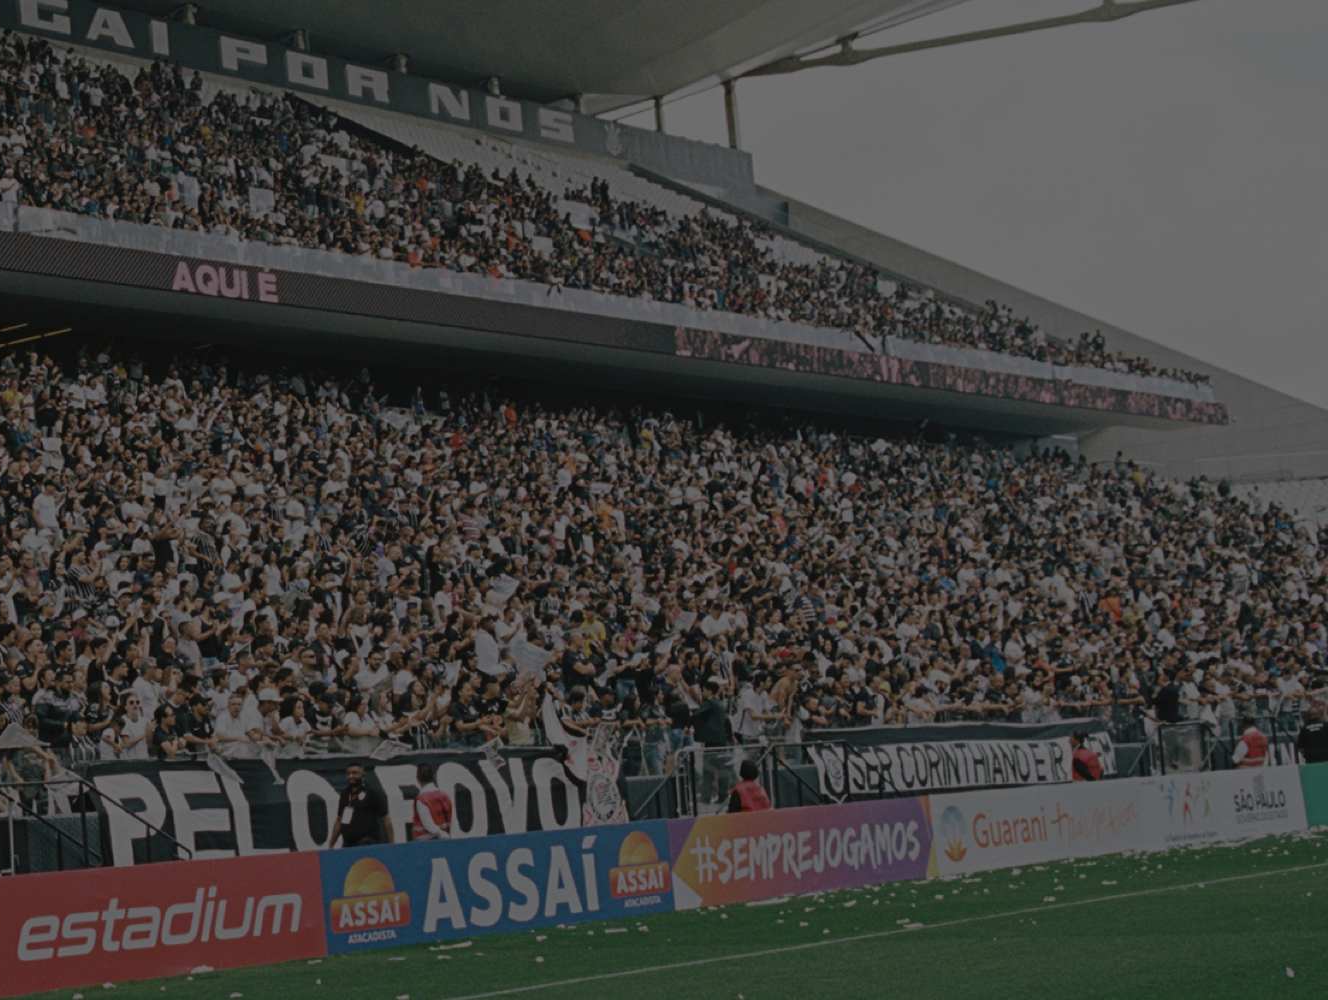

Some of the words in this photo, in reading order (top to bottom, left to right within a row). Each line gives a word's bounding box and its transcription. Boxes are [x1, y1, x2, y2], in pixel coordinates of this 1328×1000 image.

[220, 35, 389, 103] POR
[428, 81, 574, 143] NÓS
[173, 261, 249, 299] AQUI
[896, 743, 1030, 788] CORINTHIANO
[1233, 788, 1254, 813] SÃO
[1255, 789, 1286, 809] PAULO
[972, 805, 1048, 849] Guarani
[690, 817, 921, 885] #SEMPREJOGAMOS
[423, 835, 599, 933] ASSAÍ
[17, 885, 302, 962] estadium
[339, 895, 401, 928] ASSAÍ
